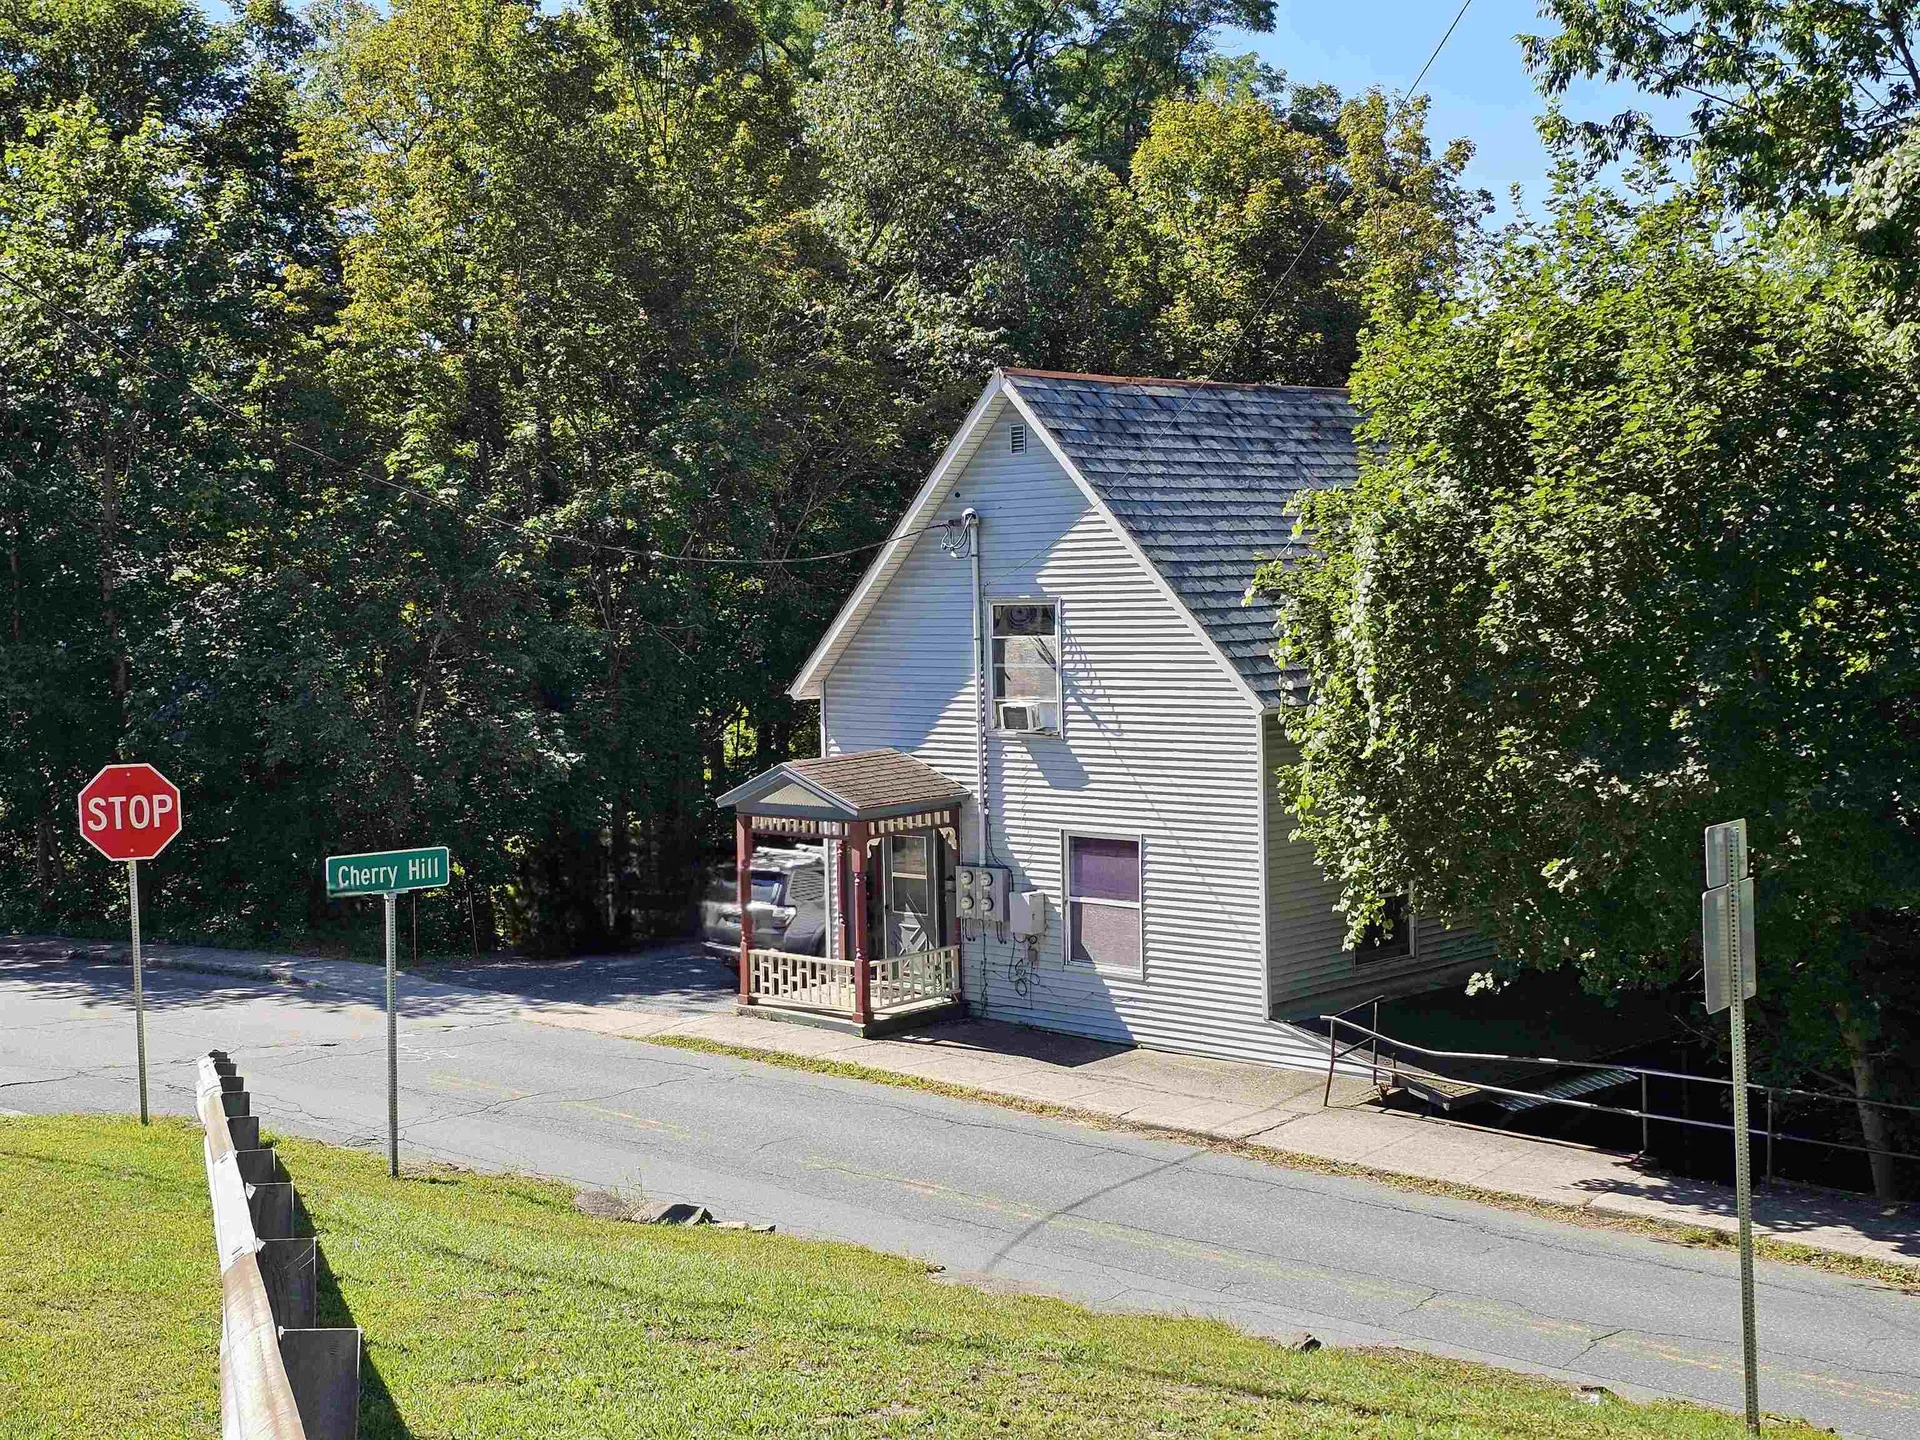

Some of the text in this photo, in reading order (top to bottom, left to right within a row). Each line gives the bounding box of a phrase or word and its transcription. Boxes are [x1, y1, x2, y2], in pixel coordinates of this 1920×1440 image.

[87, 794, 173, 831] STOP
[338, 857, 439, 888] Cherry Hill
